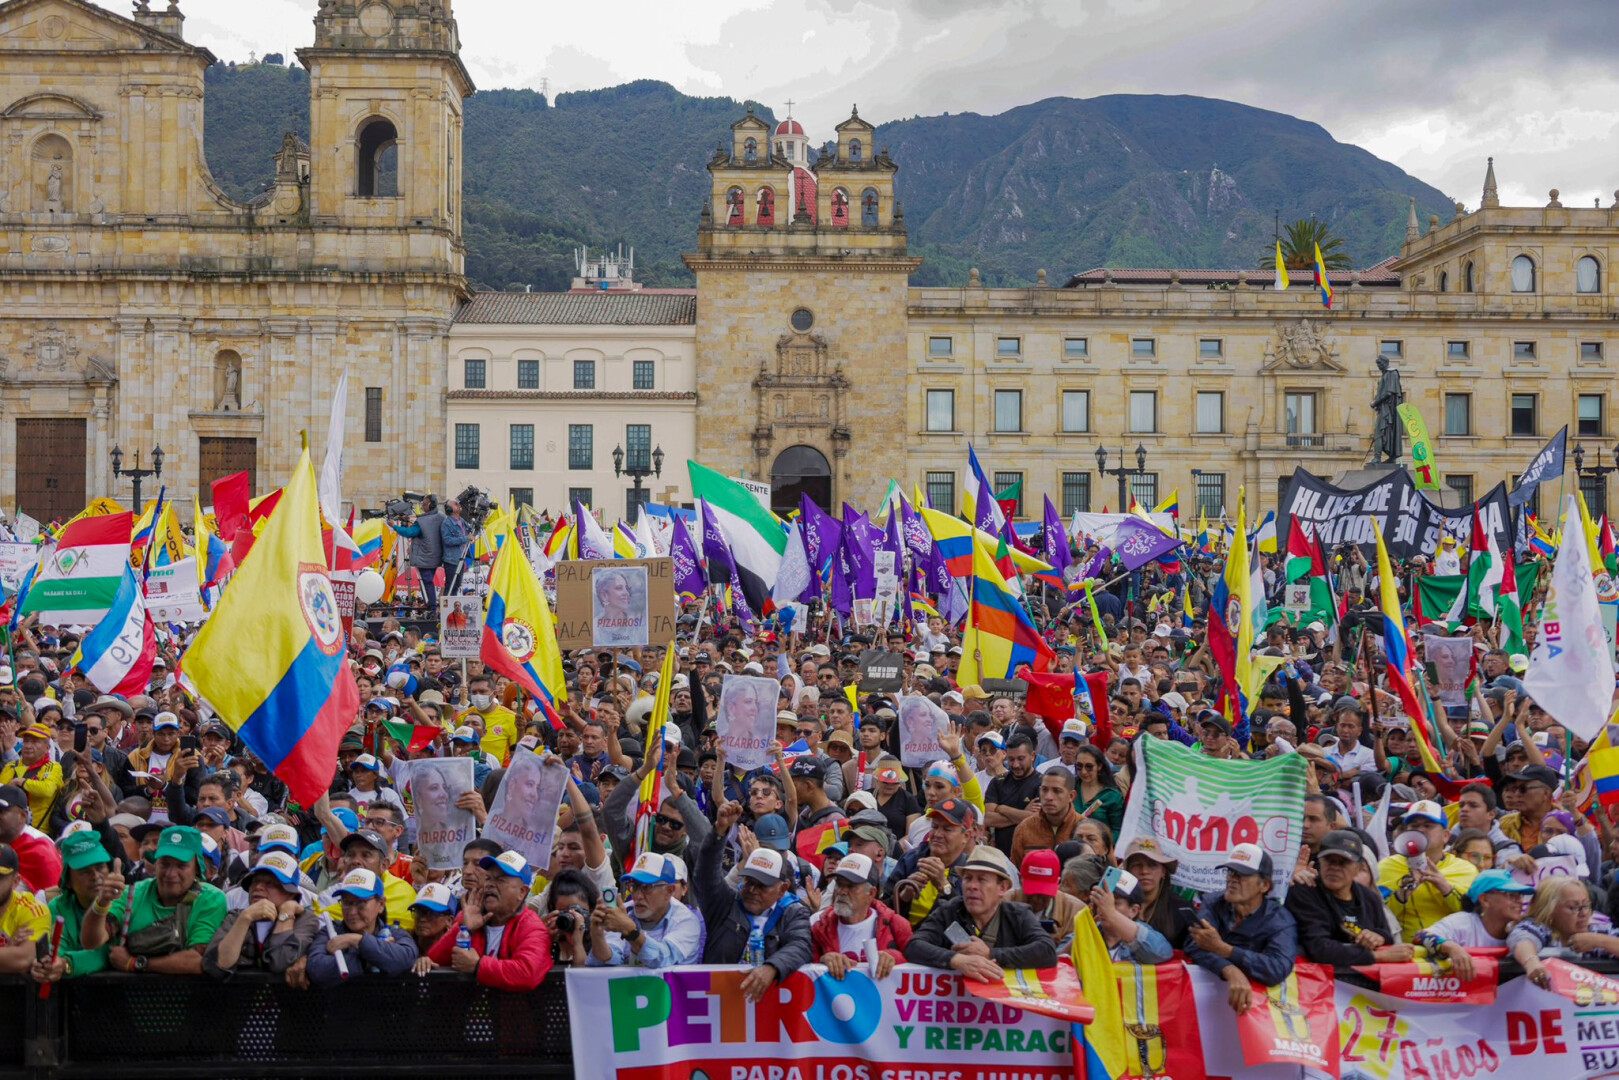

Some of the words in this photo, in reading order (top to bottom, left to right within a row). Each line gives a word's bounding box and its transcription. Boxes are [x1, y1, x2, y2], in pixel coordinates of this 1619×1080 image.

[1362, 483, 1393, 511] DE
[1399, 484, 1422, 519] LA
[335, 592, 354, 601] CIÓN
[337, 600, 353, 608] CHOS
[1543, 585, 1564, 659] OMBIA
[904, 743, 943, 753] PIZARROS
[895, 972, 966, 997] JUST
[1412, 977, 1461, 991] MAYO
[607, 970, 883, 1053] PETRO
[894, 999, 1024, 1024] VERDAD
[893, 1025, 915, 1049] Y
[1341, 1006, 1400, 1062] 27
[1506, 1008, 1568, 1057] DE
[1576, 1021, 1619, 1042] ME
[1273, 1037, 1322, 1058] MAYO
